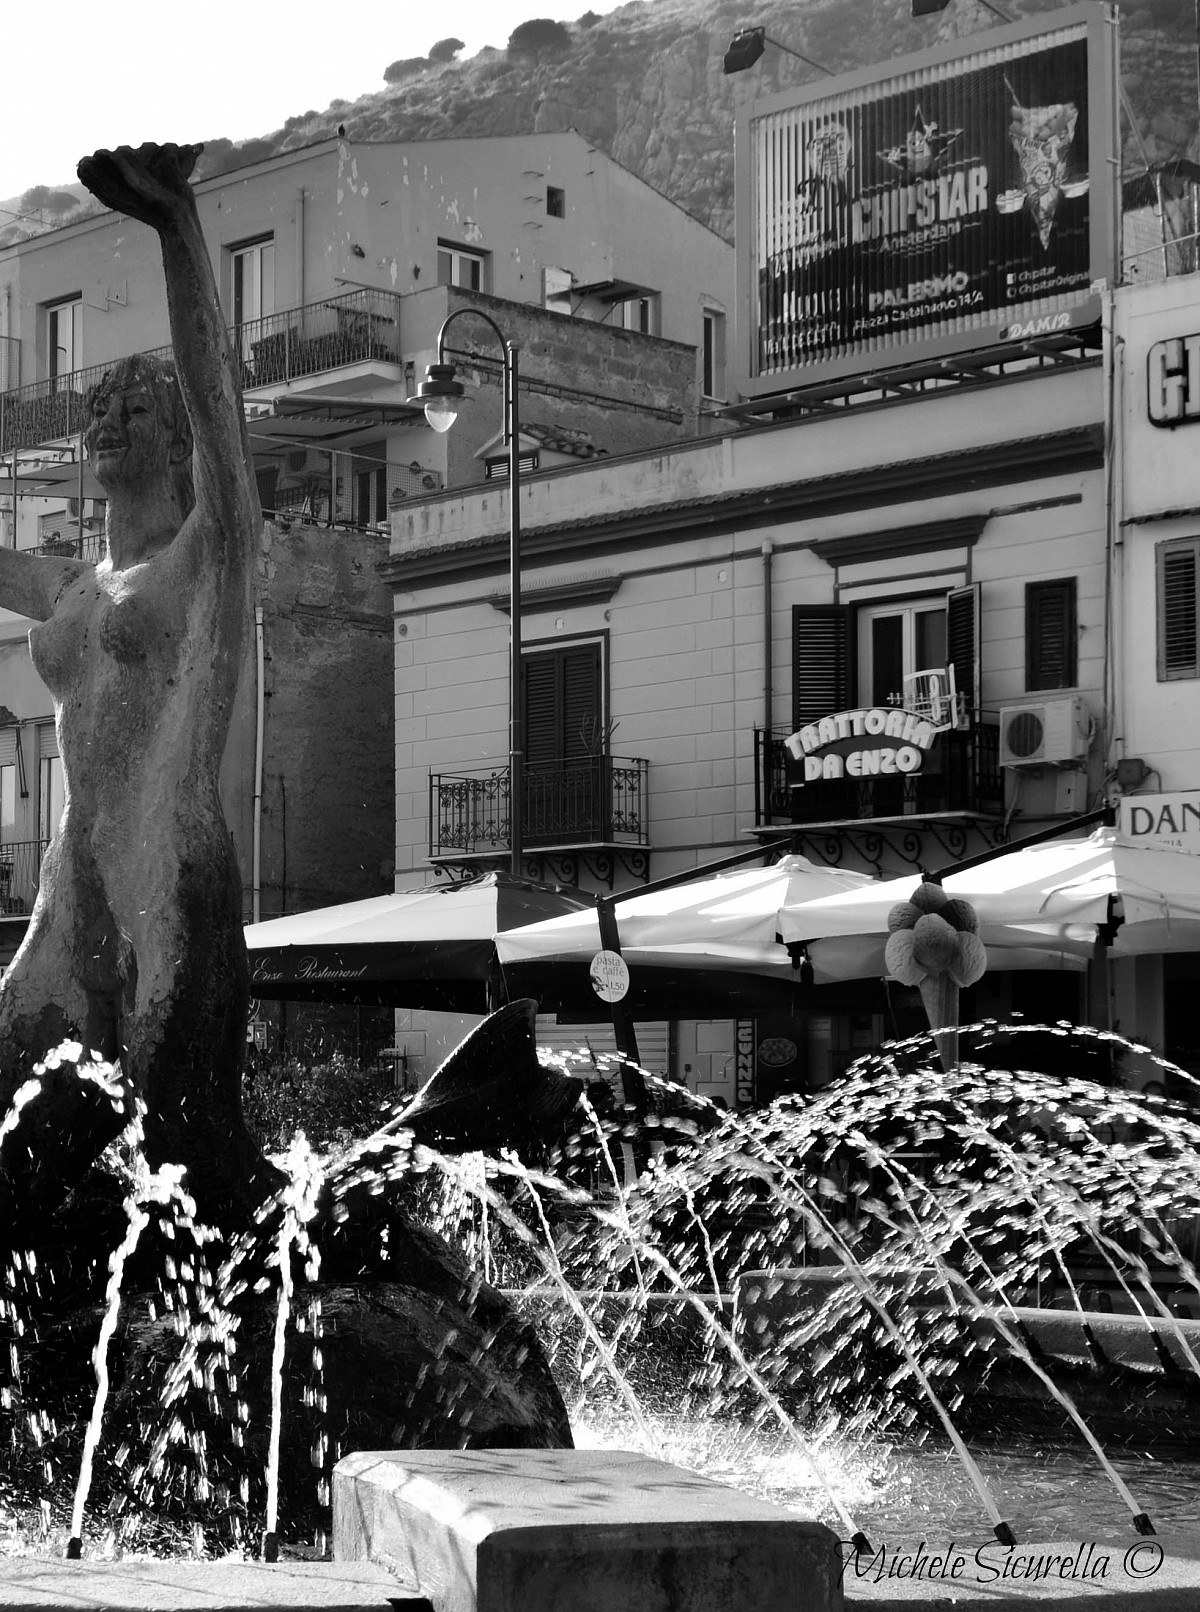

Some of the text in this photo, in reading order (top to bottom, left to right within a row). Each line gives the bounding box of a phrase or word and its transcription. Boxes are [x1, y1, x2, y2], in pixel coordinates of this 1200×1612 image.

[868, 271, 969, 312] PALERMO
[784, 709, 937, 761] TRATTORIA
[804, 746, 922, 781] DA ENZO
[294, 955, 368, 980] Restaurant
[597, 957, 621, 966] pasta
